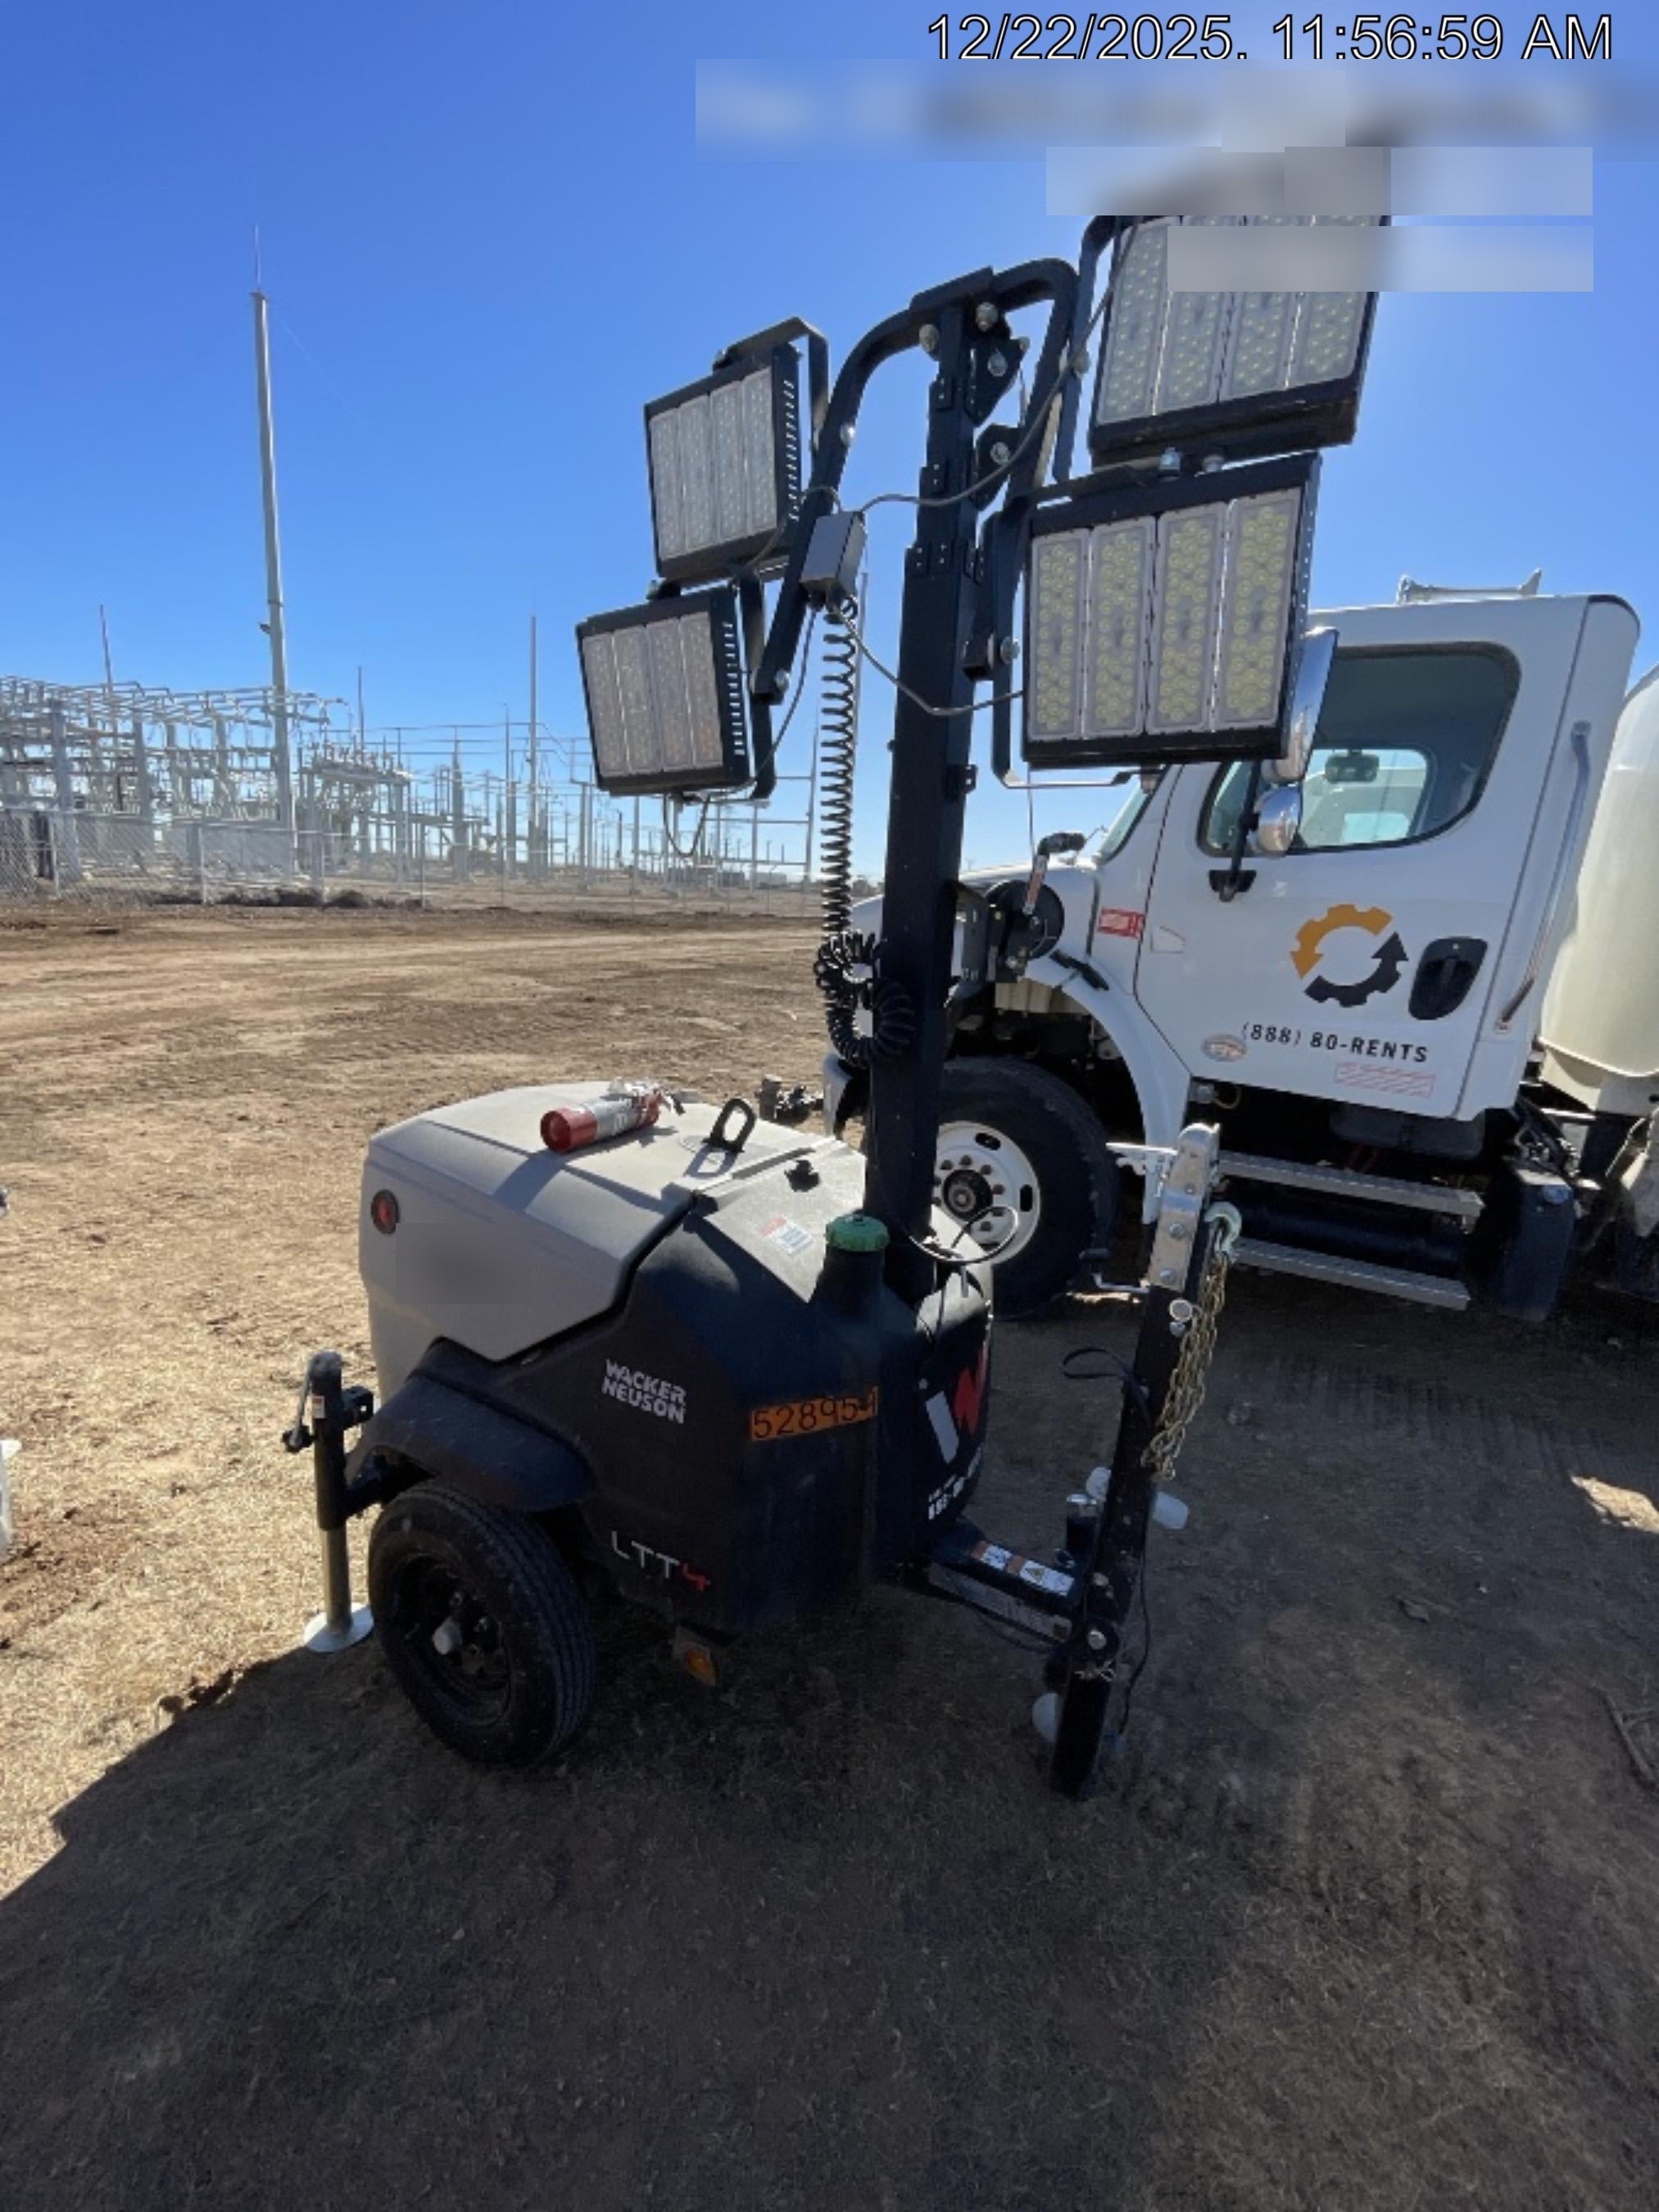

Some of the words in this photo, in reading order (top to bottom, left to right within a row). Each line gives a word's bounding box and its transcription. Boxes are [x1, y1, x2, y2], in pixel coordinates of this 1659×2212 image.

[1242, 1022, 1301, 1045] (888)
[1310, 1031, 1429, 1063] 80-RENTS
[602, 1376, 685, 1424] NEUSON
[605, 1359, 687, 1404] WACKER
[611, 1530, 710, 1591] LTT4
